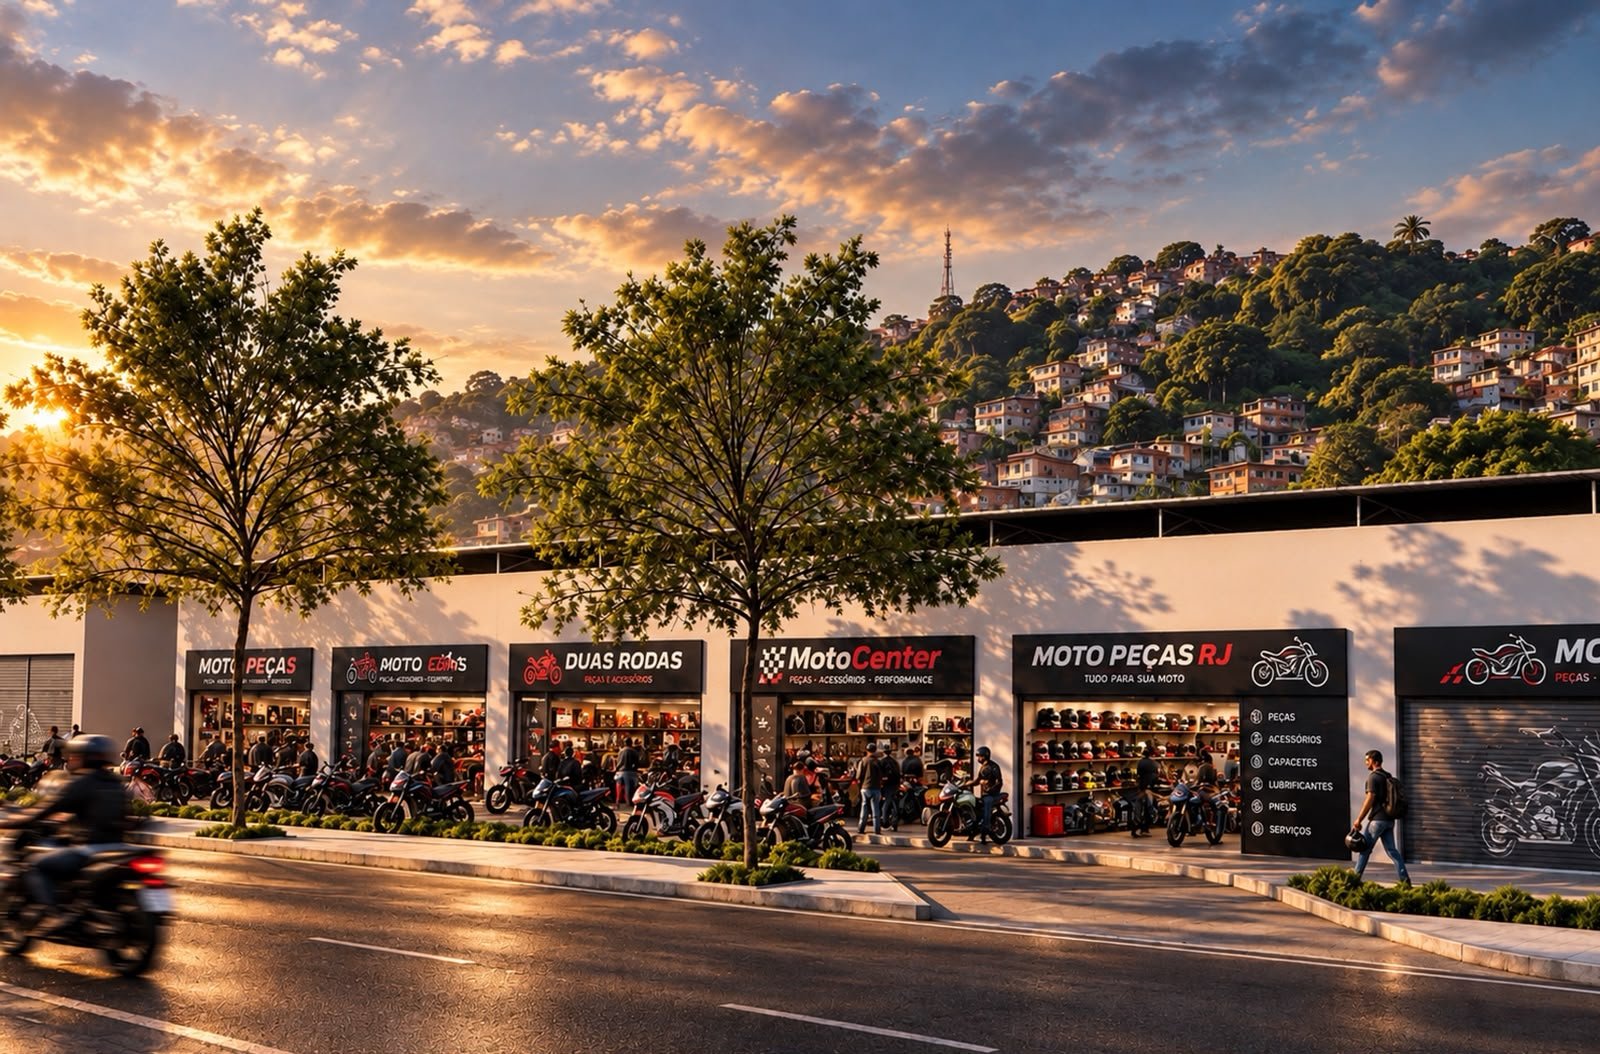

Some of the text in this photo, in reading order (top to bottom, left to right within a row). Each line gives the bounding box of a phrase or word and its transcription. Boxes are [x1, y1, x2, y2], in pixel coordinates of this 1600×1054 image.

[565, 651, 683, 670] DUAS RODAS
[788, 645, 942, 670] MotoCenter
[1031, 643, 1233, 672] MOTO PEÇAS RJ
[246, 656, 297, 679] PEÇAS
[380, 656, 423, 672] MOTO
[789, 674, 933, 685] PEÇAS ACESSÓRIOS PERFORMANCE
[1111, 674, 1135, 683] PARA
[1137, 674, 1156, 683] SUA
[1158, 674, 1185, 683] MOTO
[1554, 672, 1590, 685] PEÇAS
[1268, 712, 1296, 723] PEÇAS
[1268, 733, 1322, 744] ACESSÓRIOS
[1268, 757, 1318, 767] CAPACETES
[1268, 780, 1334, 791] LUBRIFICANTES
[1268, 802, 1297, 812] PNEUS
[1269, 825, 1312, 837] SERVIÇOS
